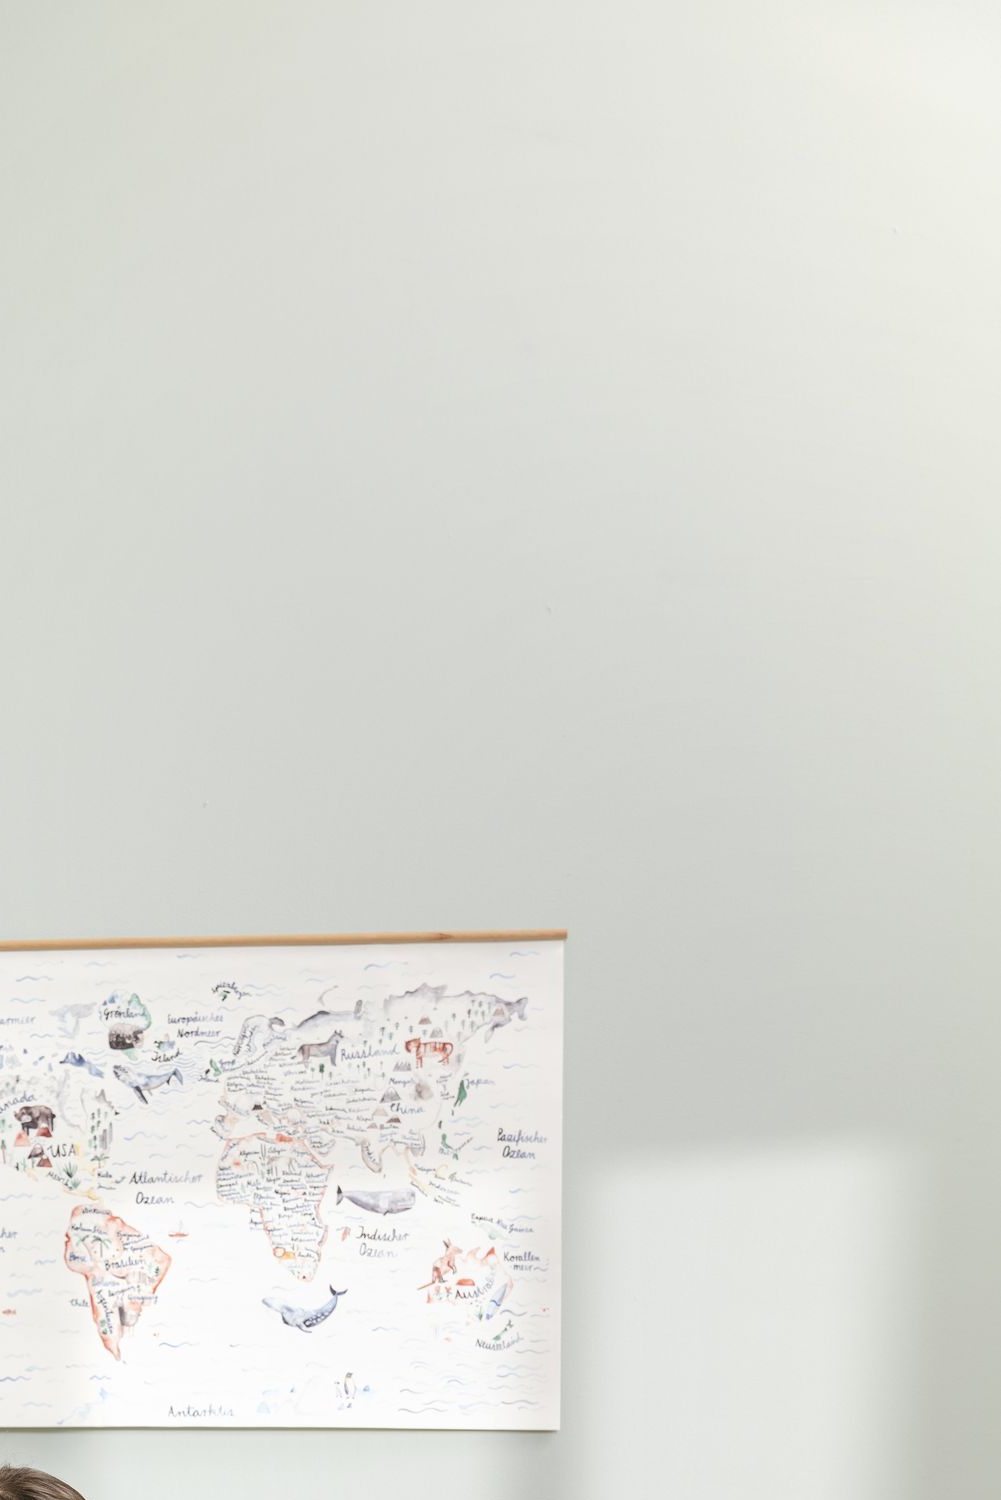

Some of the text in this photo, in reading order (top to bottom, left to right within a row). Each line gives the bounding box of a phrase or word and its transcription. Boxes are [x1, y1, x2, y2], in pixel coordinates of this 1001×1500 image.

[177, 1027, 221, 1038] Nordmeer
[152, 1048, 183, 1062] Island
[341, 1044, 400, 1062] Russland
[390, 1103, 424, 1114] China
[497, 1127, 548, 1146] Pazifischer
[47, 1143, 77, 1158] USA
[502, 1145, 536, 1159] Ozean
[129, 1170, 202, 1184] Atlantischer
[136, 1191, 175, 1205] Ozean
[356, 1225, 410, 1241] Indischer
[360, 1242, 397, 1257] Ozean
[503, 1251, 540, 1262] Korallen
[168, 1404, 234, 1418] Antarktis
